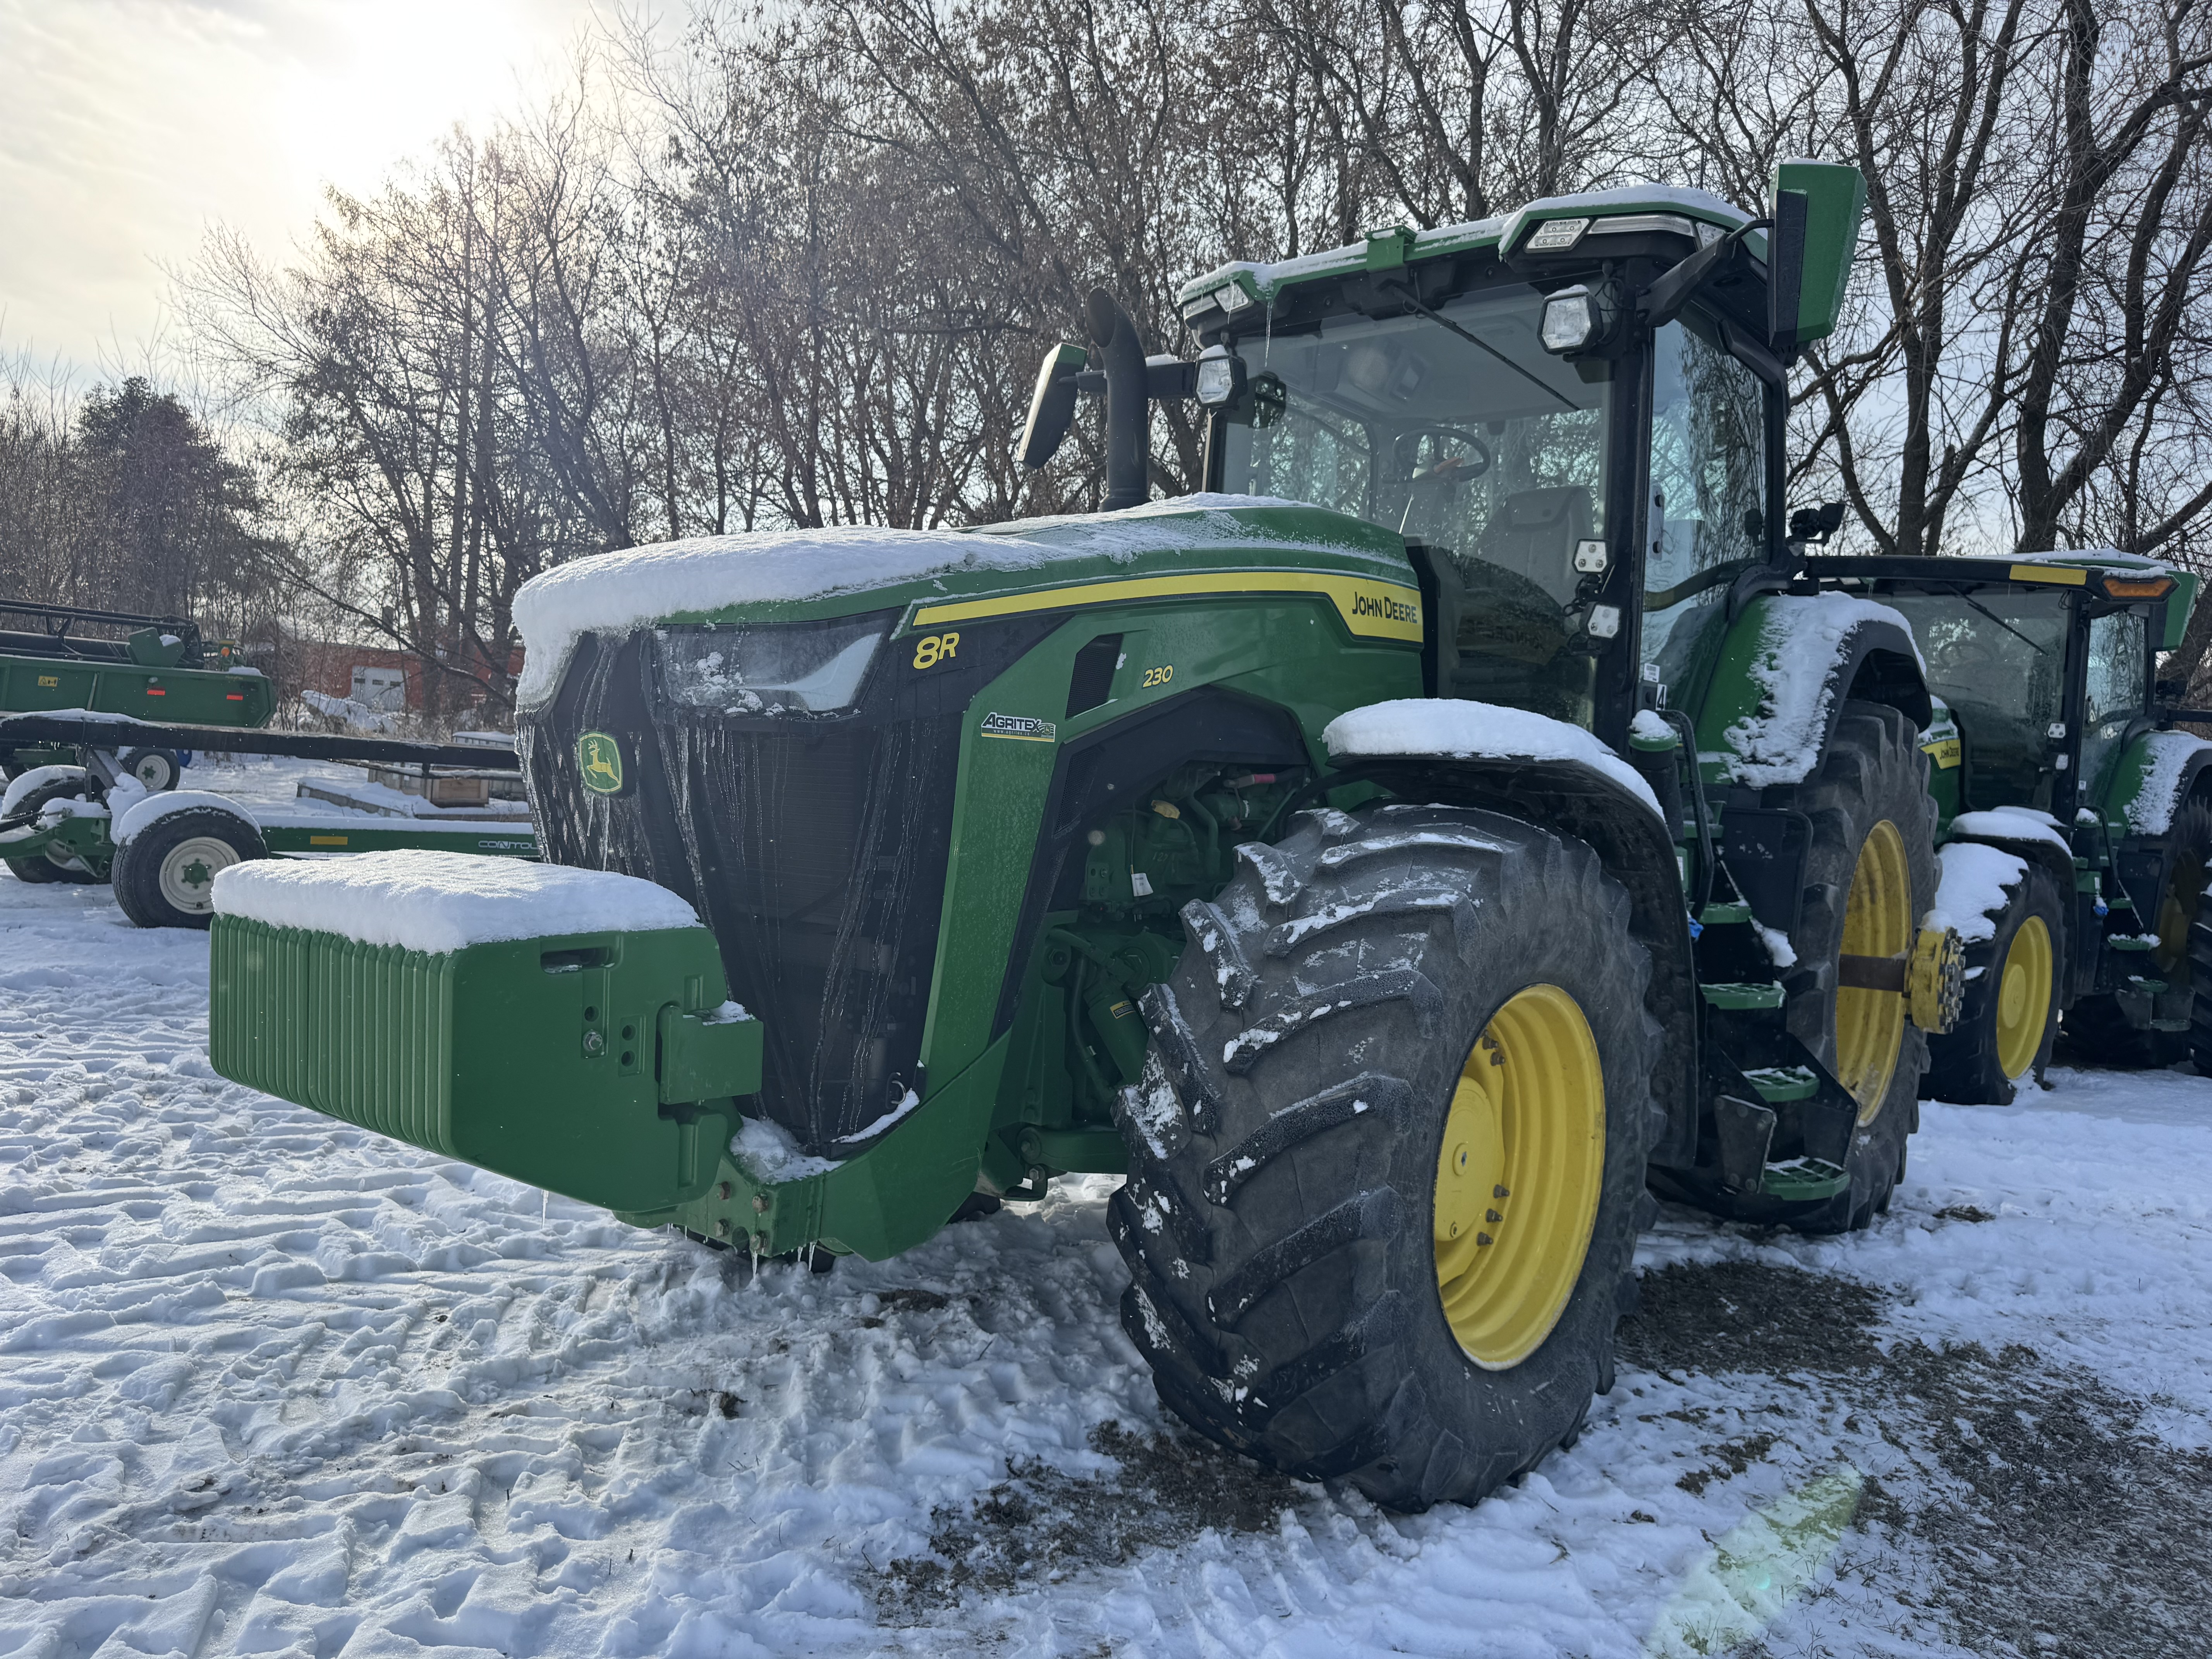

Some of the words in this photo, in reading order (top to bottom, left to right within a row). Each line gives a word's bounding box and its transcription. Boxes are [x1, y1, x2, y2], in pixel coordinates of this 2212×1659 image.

[1352, 591, 1382, 618] JOHN
[1384, 596, 1417, 624] DEERE
[913, 632, 960, 670] 8R
[1142, 665, 1173, 688] 230
[1657, 685, 1665, 711] 4
[982, 714, 1040, 732] AGRITEX
